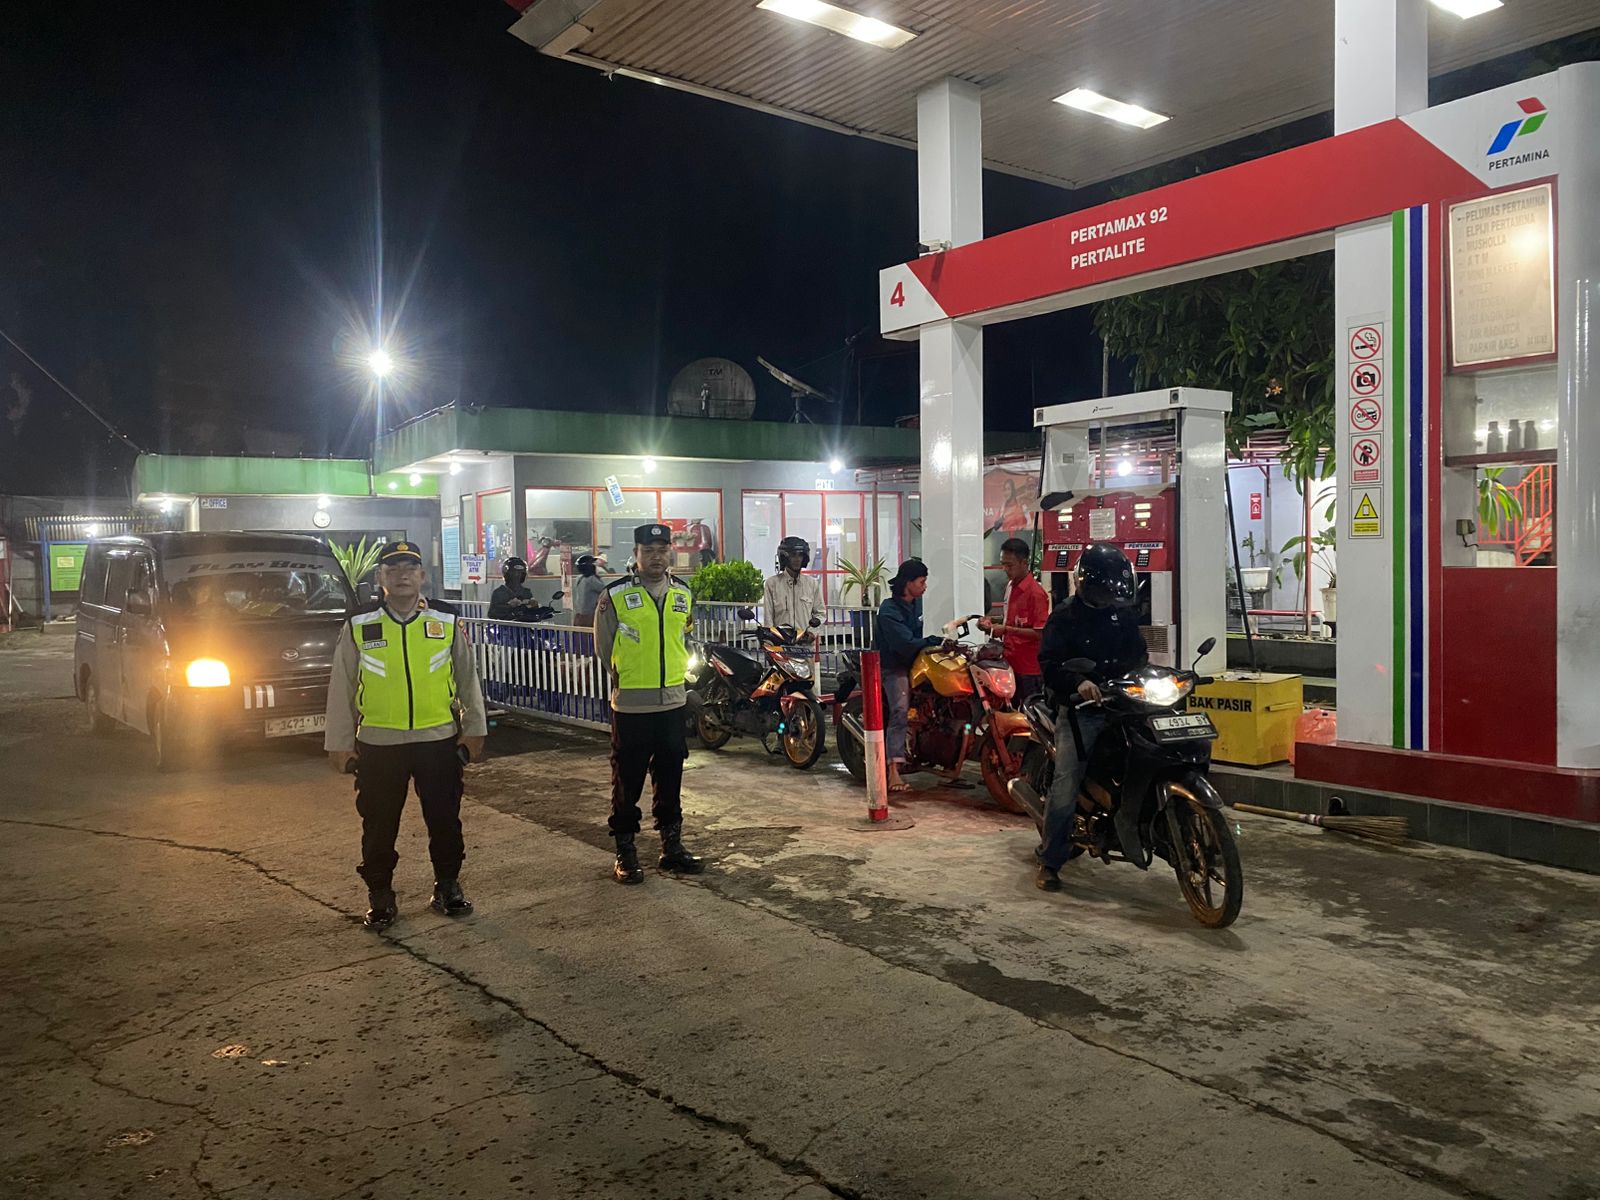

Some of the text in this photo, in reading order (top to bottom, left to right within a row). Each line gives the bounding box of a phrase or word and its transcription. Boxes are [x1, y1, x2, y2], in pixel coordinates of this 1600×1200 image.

[1488, 149, 1550, 170] PERTAMINA
[1466, 196, 1546, 222] PELUMAS PERTAMINA
[1070, 206, 1168, 244] PERTAMAX 92
[1070, 238, 1145, 270] PERTALITE
[890, 282, 905, 307] 4
[1190, 696, 1252, 712] BAK PASIR
